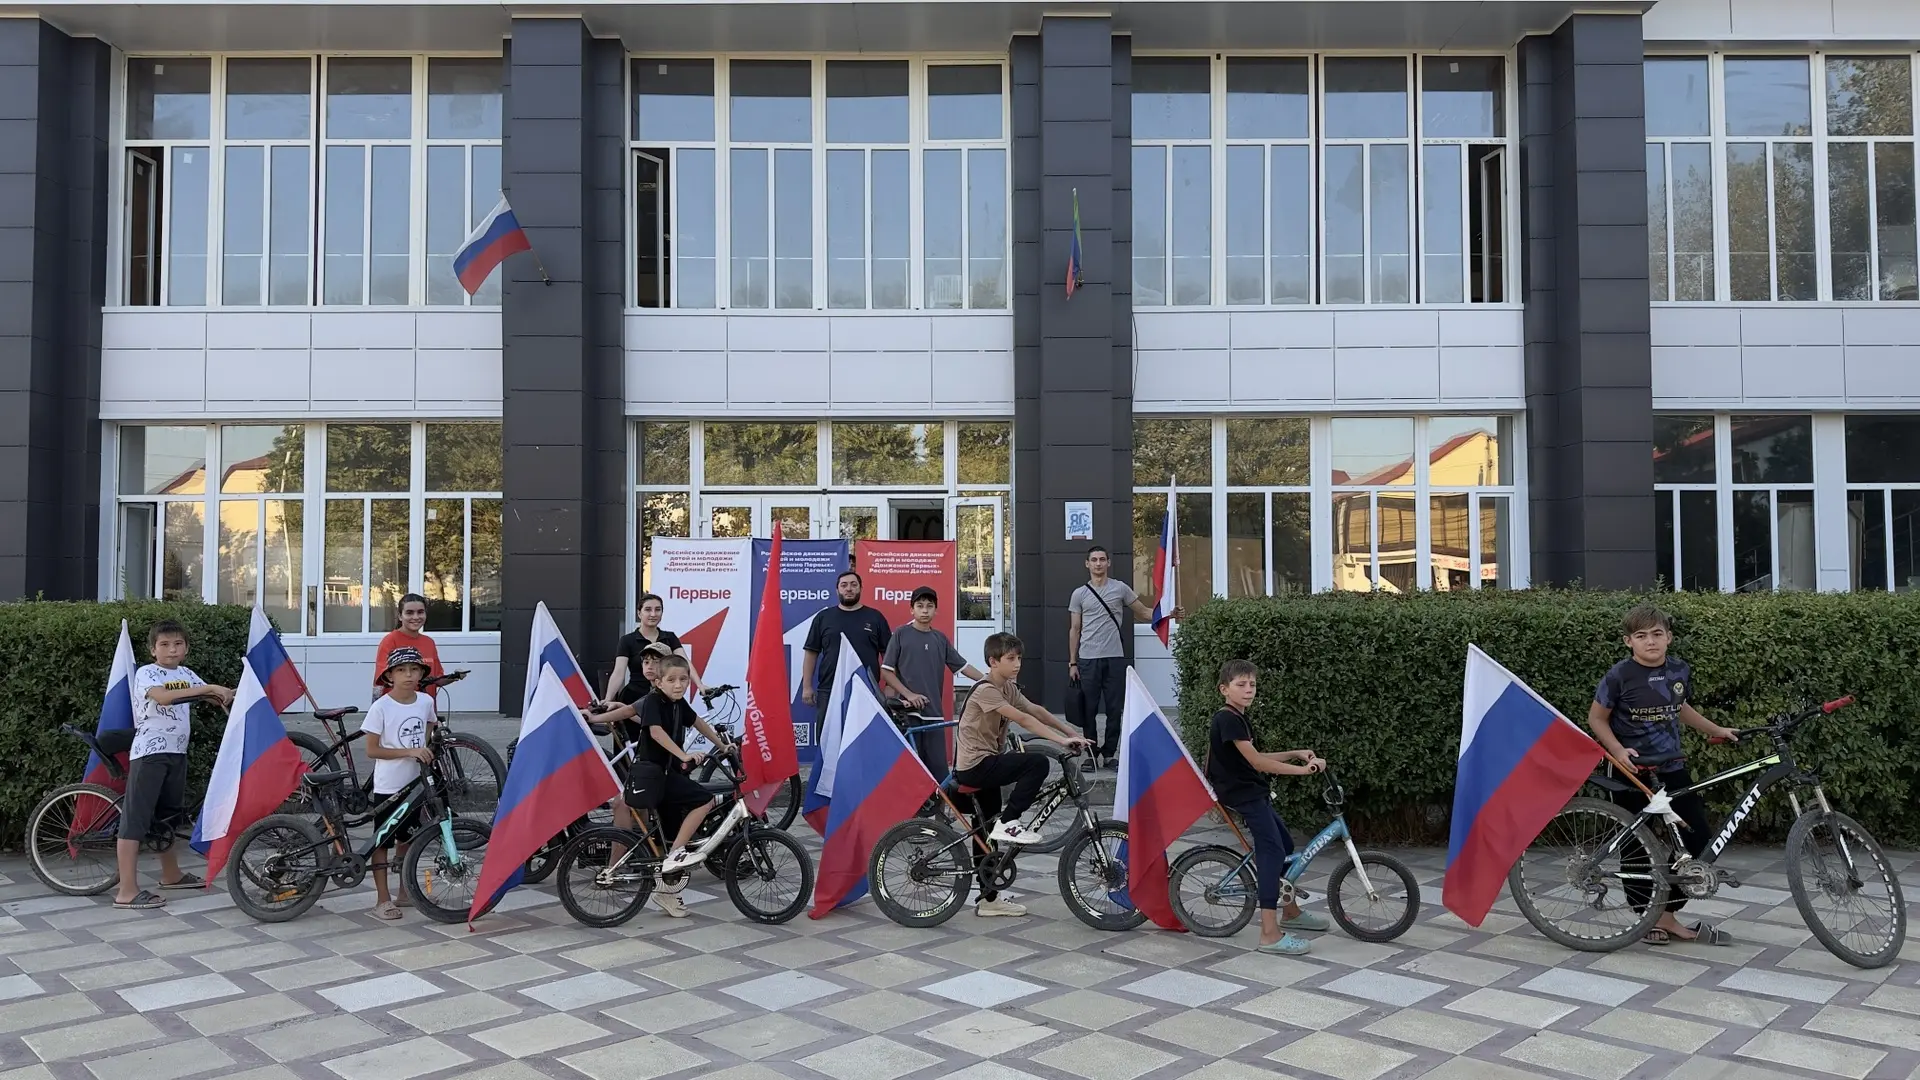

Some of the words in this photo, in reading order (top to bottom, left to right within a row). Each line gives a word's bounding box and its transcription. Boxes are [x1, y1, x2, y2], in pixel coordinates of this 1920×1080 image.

[669, 586, 732, 604] Первые
[780, 589, 830, 604] ервые
[874, 587, 913, 604] Перв
[1628, 704, 1682, 714] WRESTLI
[746, 682, 772, 762] публика
[1710, 783, 1762, 856] DMART
